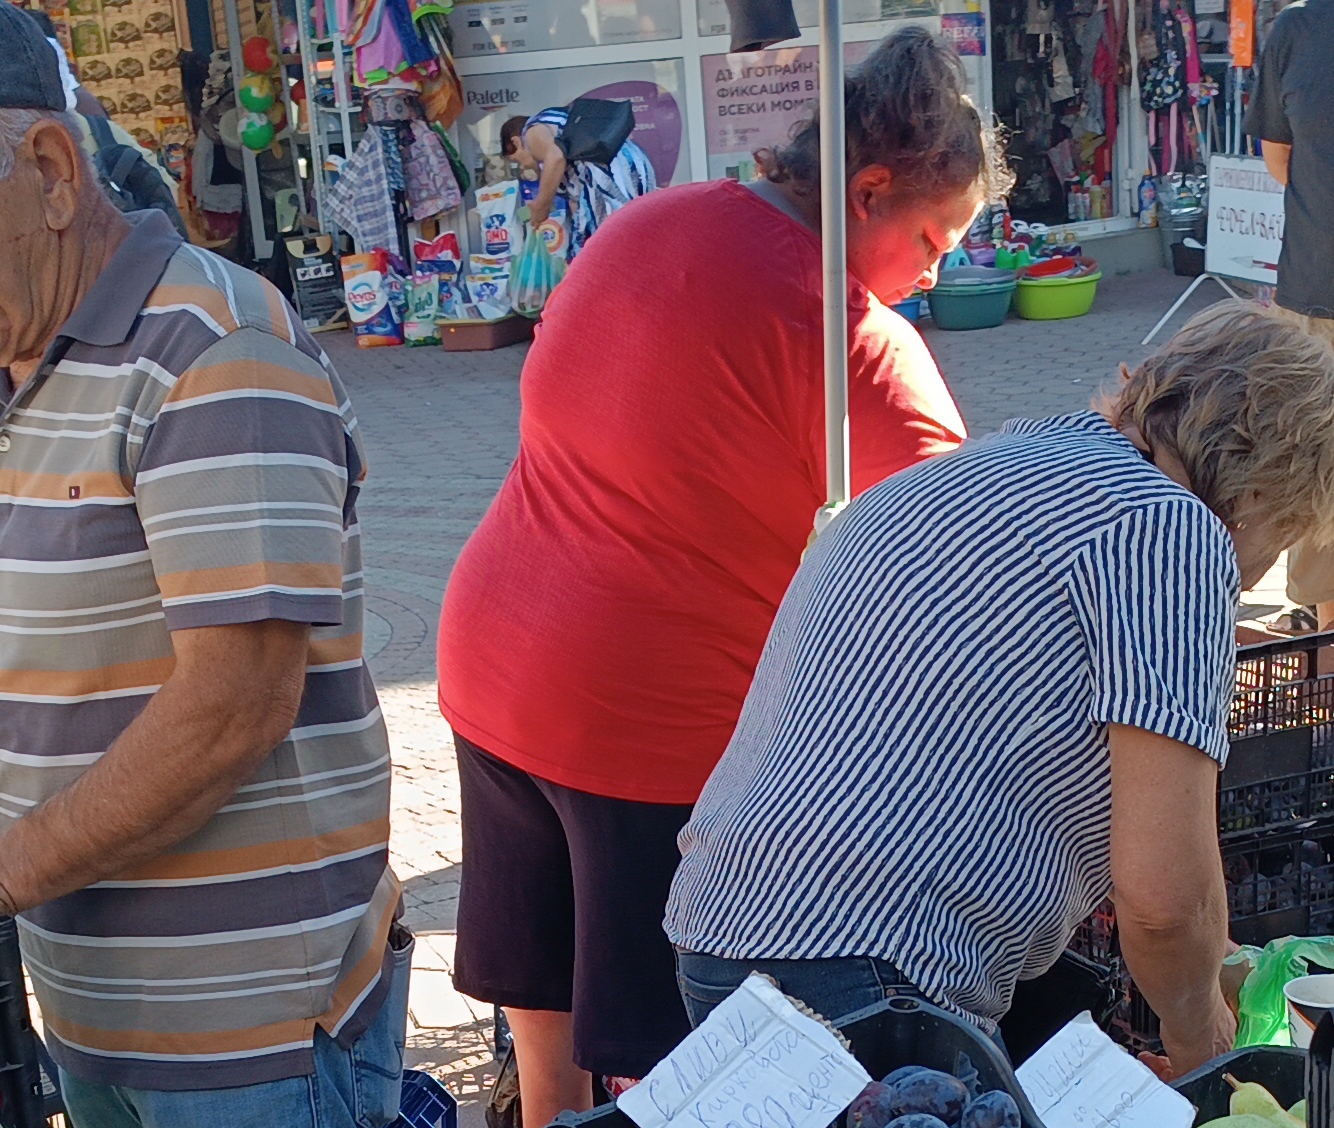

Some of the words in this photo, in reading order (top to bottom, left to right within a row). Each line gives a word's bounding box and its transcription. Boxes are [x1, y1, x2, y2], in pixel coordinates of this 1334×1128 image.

[467, 89, 520, 105] Palette
[717, 80, 801, 99] ФИКСАЦИЯ
[718, 102, 767, 117] ВСЕКИ
